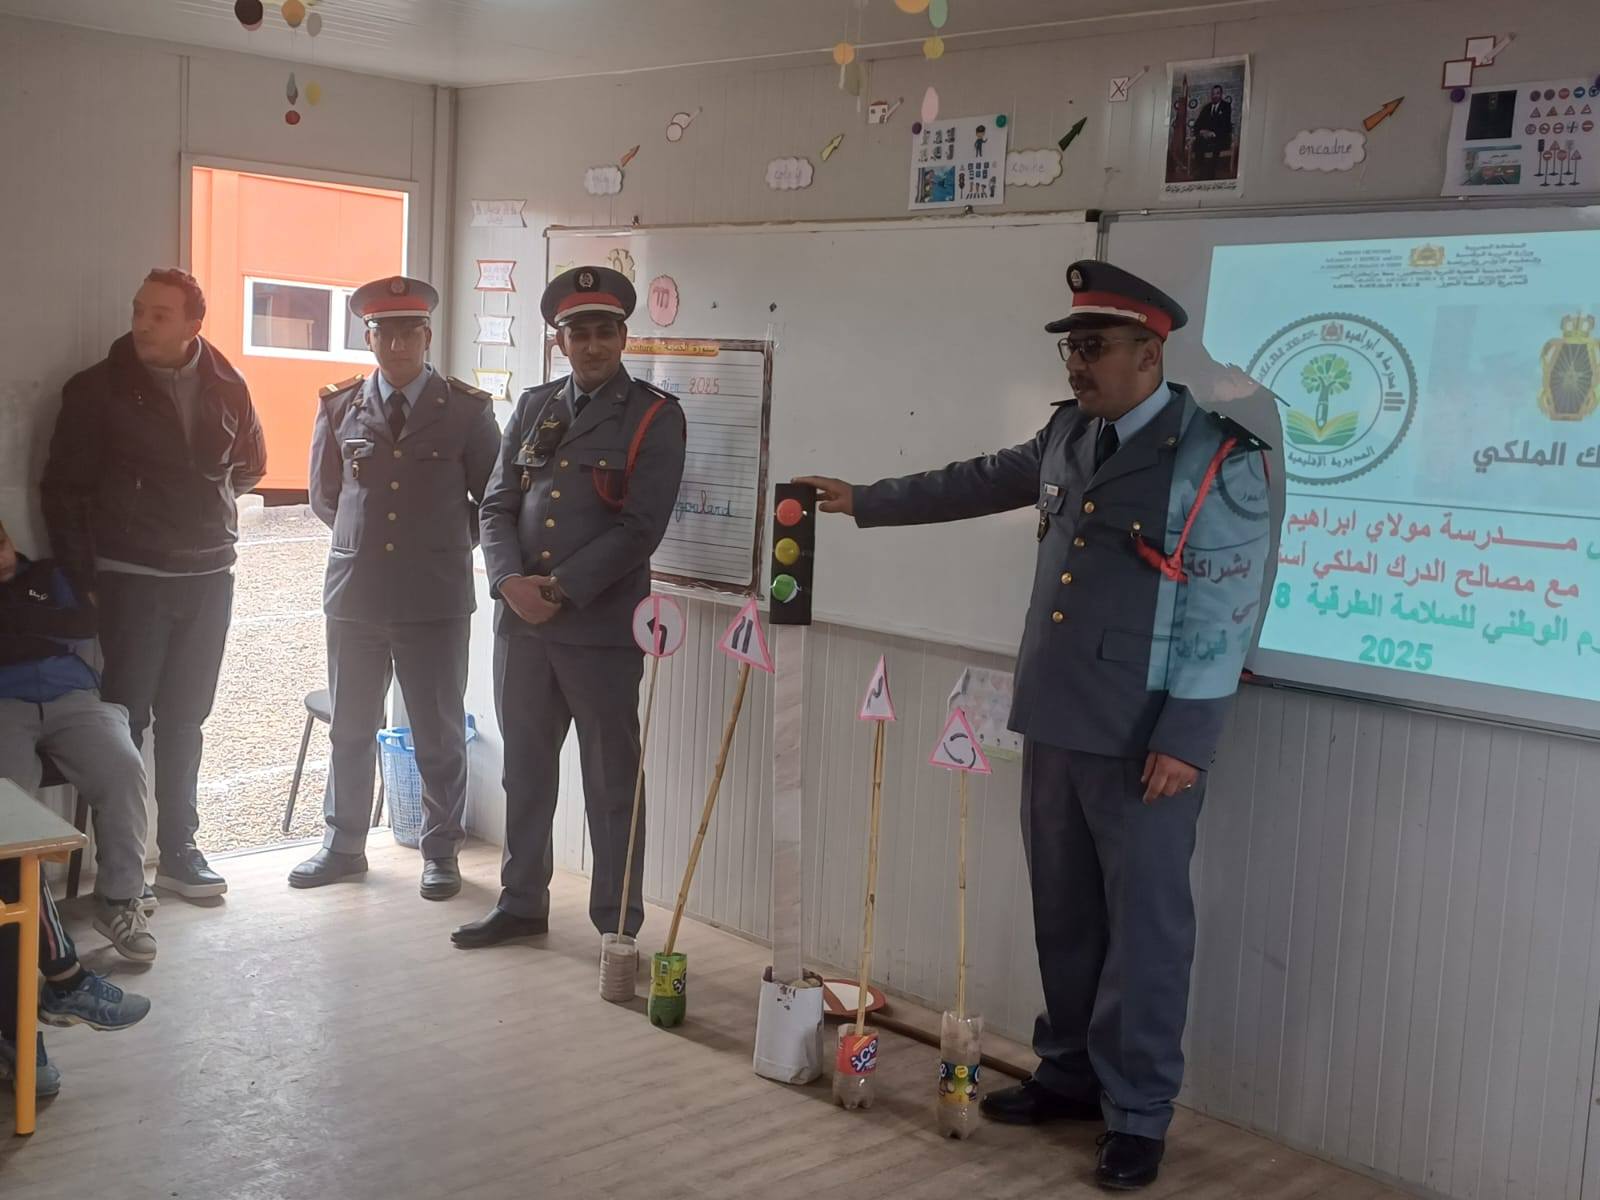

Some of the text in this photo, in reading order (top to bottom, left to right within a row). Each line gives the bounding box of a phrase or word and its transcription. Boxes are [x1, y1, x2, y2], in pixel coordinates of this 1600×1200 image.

[1472, 439, 1568, 474] الملكي
[1287, 506, 1357, 537] ابراهيم
[1366, 512, 1432, 543] مولاي
[1185, 552, 1251, 584] بشراكة
[1313, 548, 1378, 580] الملكي
[1386, 554, 1446, 587] الدرك
[1454, 562, 1536, 598] مصالح
[1306, 582, 1383, 619] الطرقية
[1544, 578, 1579, 609] مع
[1390, 592, 1476, 630] للسلامة
[1482, 609, 1569, 646] الوطني
[1358, 634, 1434, 671] 2025
